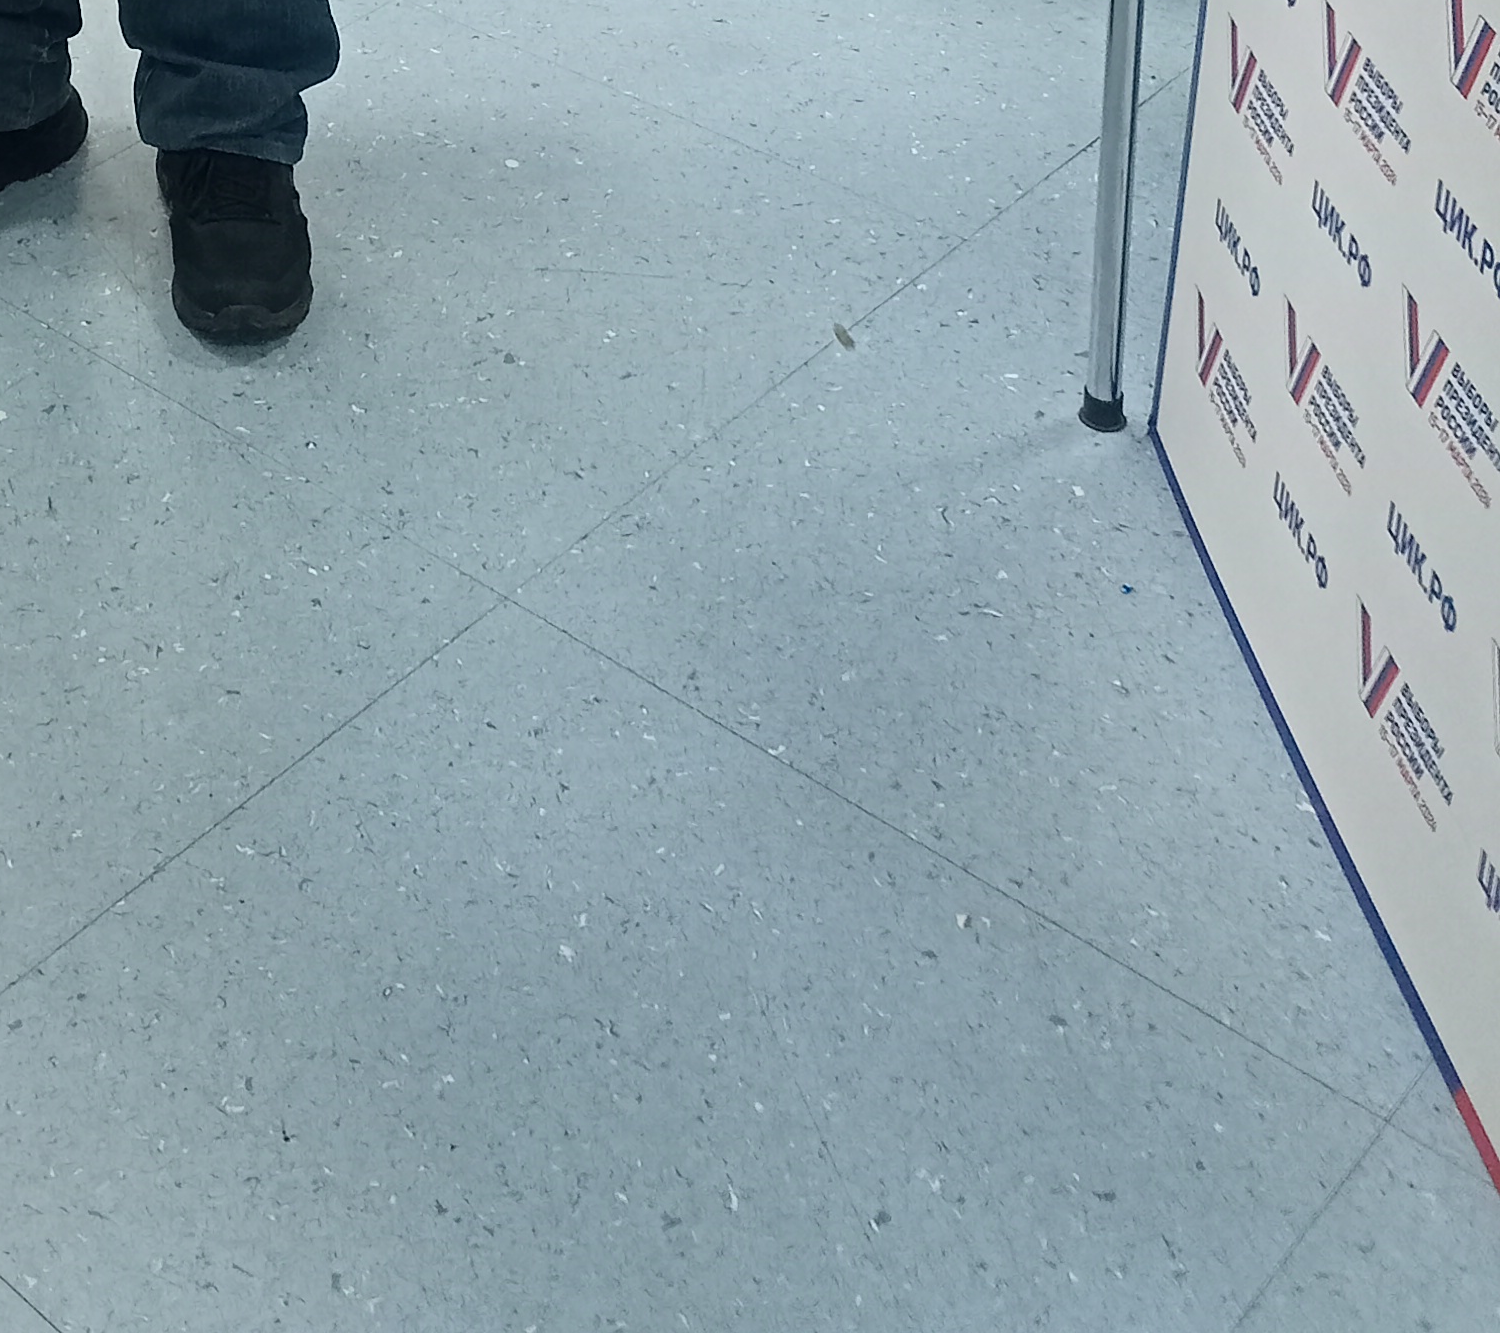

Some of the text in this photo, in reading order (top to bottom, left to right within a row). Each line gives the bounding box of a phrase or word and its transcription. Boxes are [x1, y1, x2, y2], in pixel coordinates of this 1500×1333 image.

[1215, 198, 1260, 297] ЦИК.РФ
[1312, 179, 1372, 288] ЦИК.РФ
[1434, 396, 1477, 460] РОССИИ
[1451, 362, 1499, 433] ВЫБОРЫ
[1273, 471, 1328, 588] ЦИК.РФ
[1387, 500, 1457, 632] ЦИК.РФ
